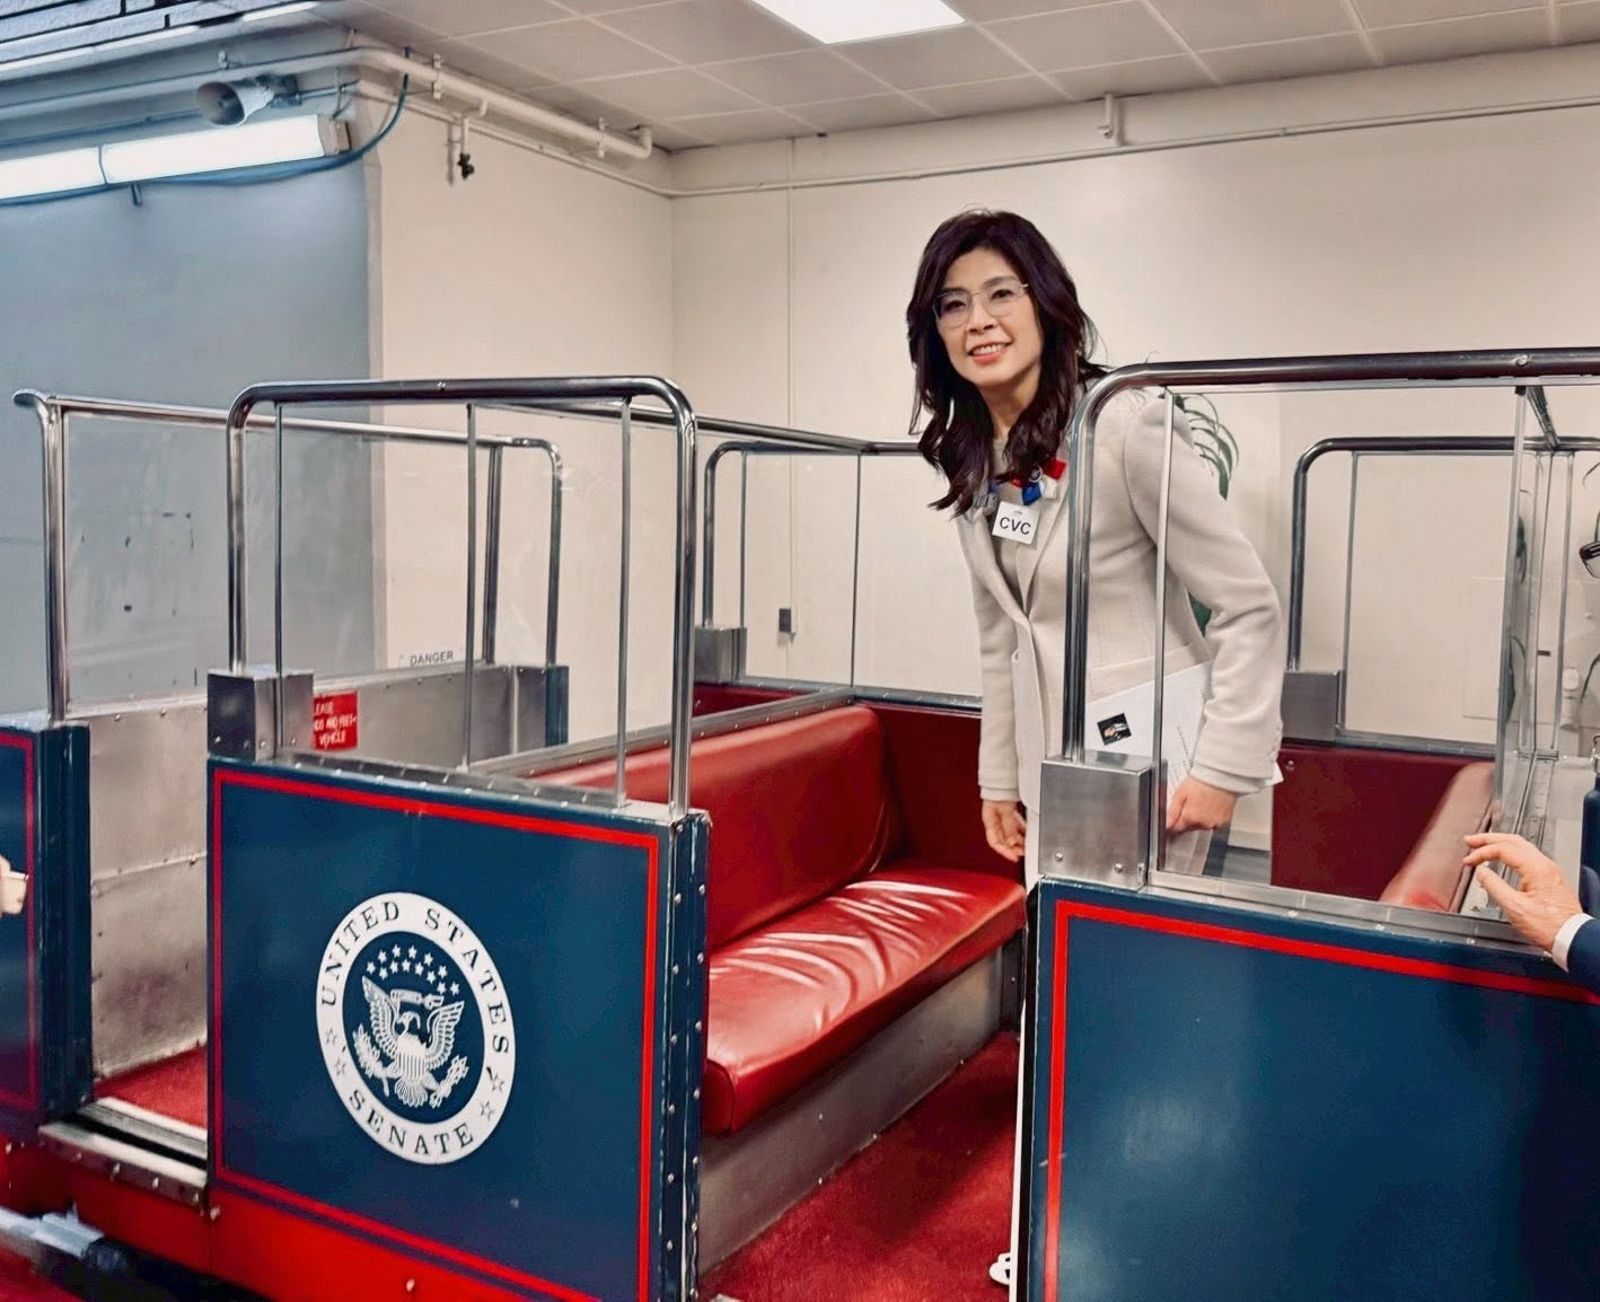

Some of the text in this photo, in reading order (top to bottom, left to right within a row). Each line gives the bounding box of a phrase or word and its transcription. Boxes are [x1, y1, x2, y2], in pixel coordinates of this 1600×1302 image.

[999, 516, 1031, 536] CVC
[409, 649, 454, 666] DANGER
[321, 900, 509, 1055] UNITED STATES
[349, 1088, 474, 1155] SENATE
